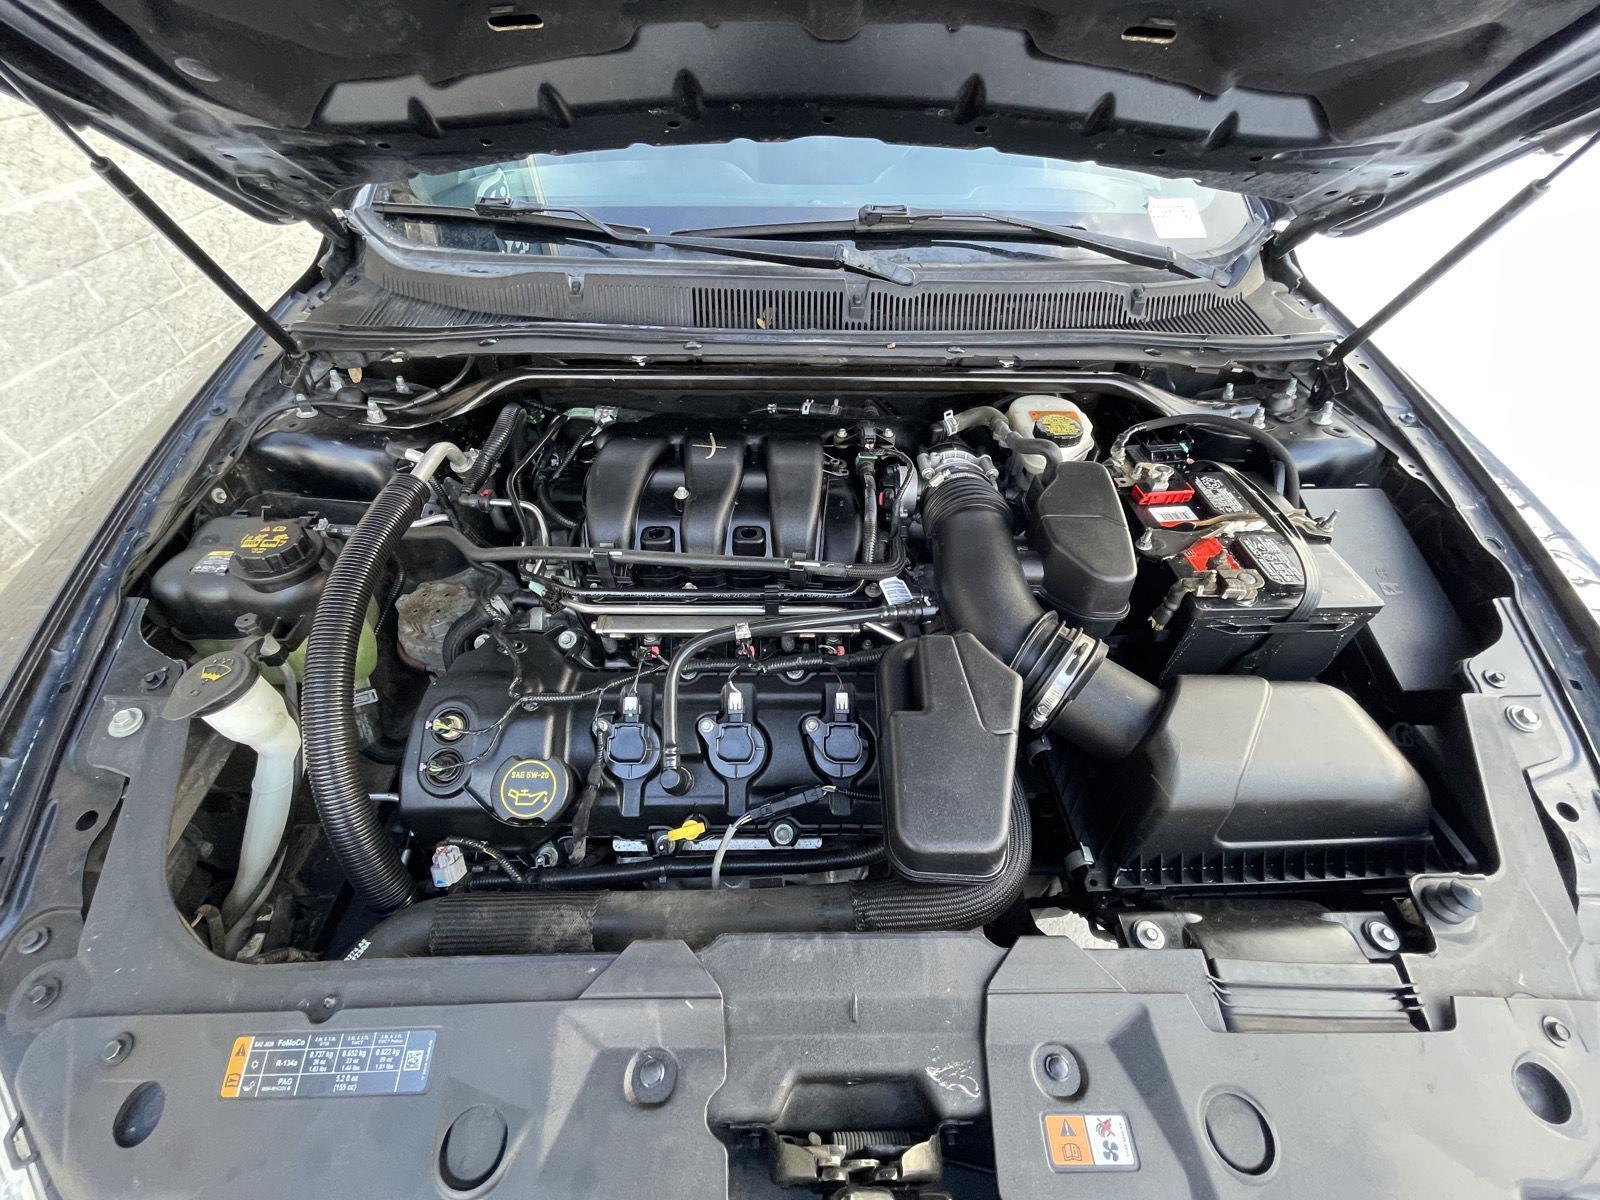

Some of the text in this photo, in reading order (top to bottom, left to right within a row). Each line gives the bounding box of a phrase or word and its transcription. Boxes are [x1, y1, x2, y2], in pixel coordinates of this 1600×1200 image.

[278, 1038, 306, 1046] FoMoCo
[326, 1050, 334, 1060] kg
[358, 1050, 367, 1058] kg
[392, 1048, 400, 1056] kg
[278, 1078, 292, 1086] PAG
[333, 1084, 357, 1093] (155 cc)
